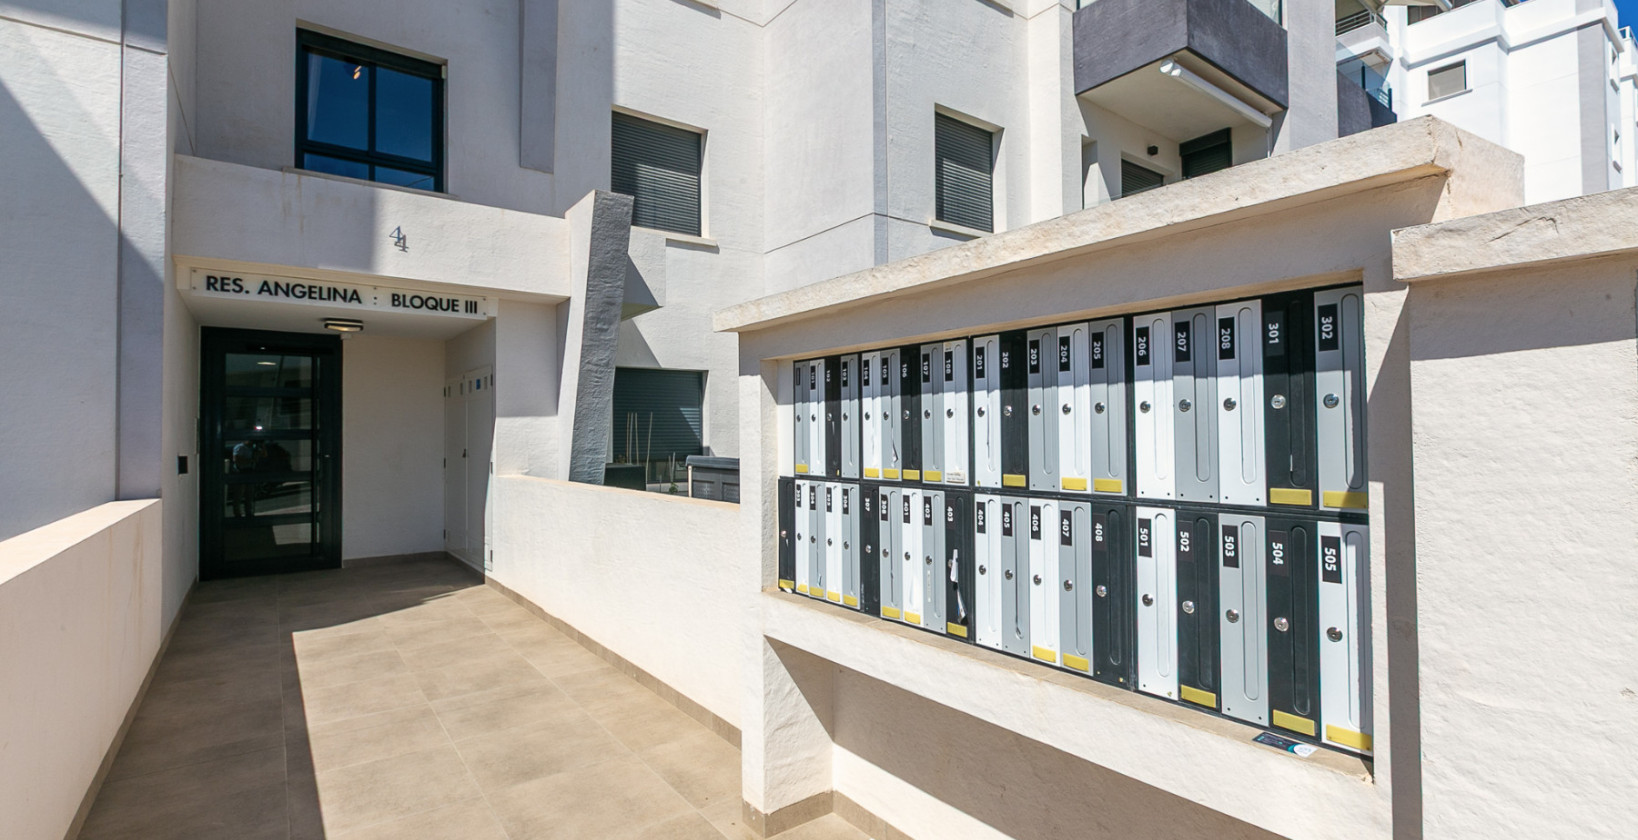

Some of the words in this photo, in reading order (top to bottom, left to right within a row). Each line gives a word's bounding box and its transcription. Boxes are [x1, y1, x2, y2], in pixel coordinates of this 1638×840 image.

[389, 225, 405, 244] 4
[206, 275, 250, 294] RES.
[257, 280, 363, 304] ANGELINA
[391, 293, 460, 313] BLOQUE
[465, 300, 478, 314] III
[1221, 328, 1231, 349] 208
[1268, 322, 1279, 344] 301
[1321, 316, 1333, 340] 302
[1093, 341, 1101, 360] 205
[1138, 336, 1146, 356] 206
[1177, 331, 1186, 352] 207
[1030, 348, 1038, 366] 203
[1060, 345, 1068, 363] 204
[1062, 518, 1070, 538] 407
[1094, 522, 1103, 542] 408
[1140, 527, 1149, 547] 501
[1180, 530, 1190, 552] 502
[1224, 535, 1235, 557] 503
[1272, 541, 1284, 565] 504
[1324, 547, 1337, 572] 505
